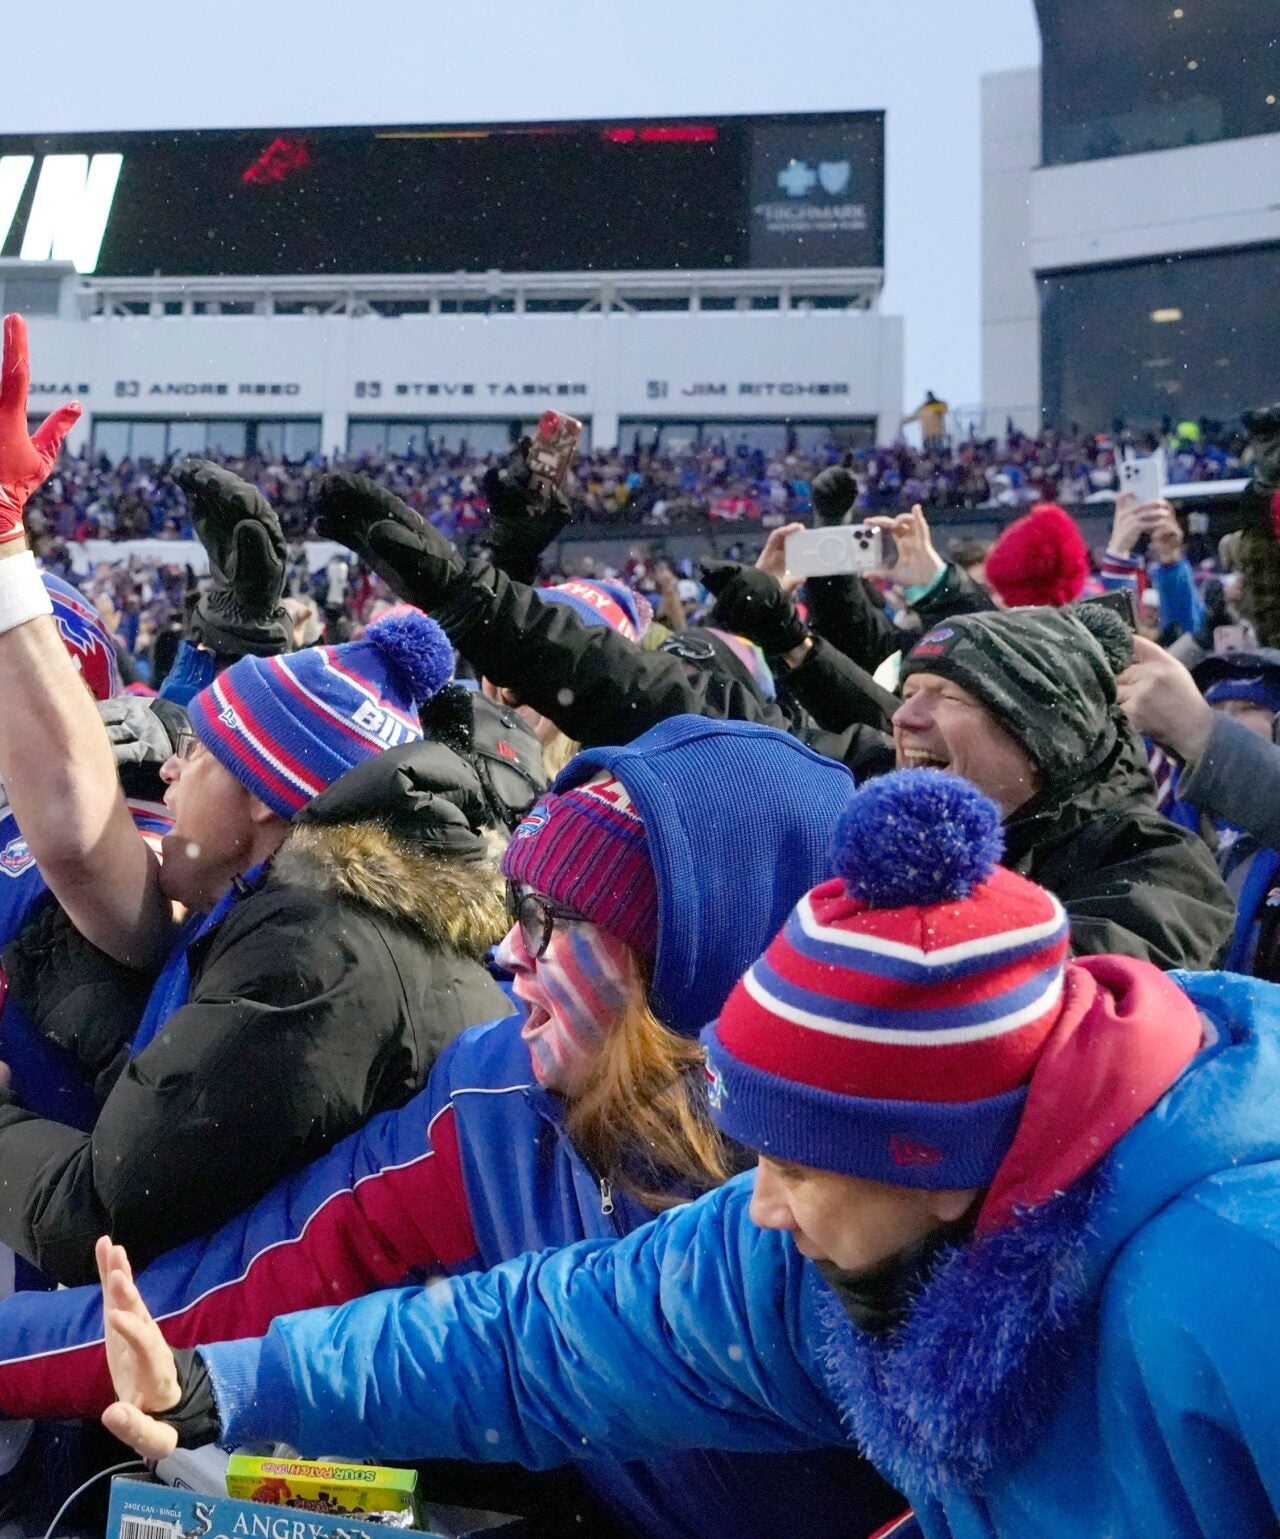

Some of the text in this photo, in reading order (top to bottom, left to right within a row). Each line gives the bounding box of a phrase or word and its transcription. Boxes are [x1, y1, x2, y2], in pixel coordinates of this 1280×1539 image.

[148, 383, 229, 395] ANDRE
[238, 383, 302, 395] REED
[396, 383, 476, 395] STEVE
[487, 382, 588, 395] TASKER
[681, 383, 727, 396] JIM
[738, 383, 850, 396] RITCHER
[288, 1464, 335, 1481] PATCH
[334, 1469, 376, 1483] SOUR
[141, 1505, 155, 1513] CAN
[160, 1508, 182, 1518] SINGLE
[233, 1511, 329, 1539] ANGRY
